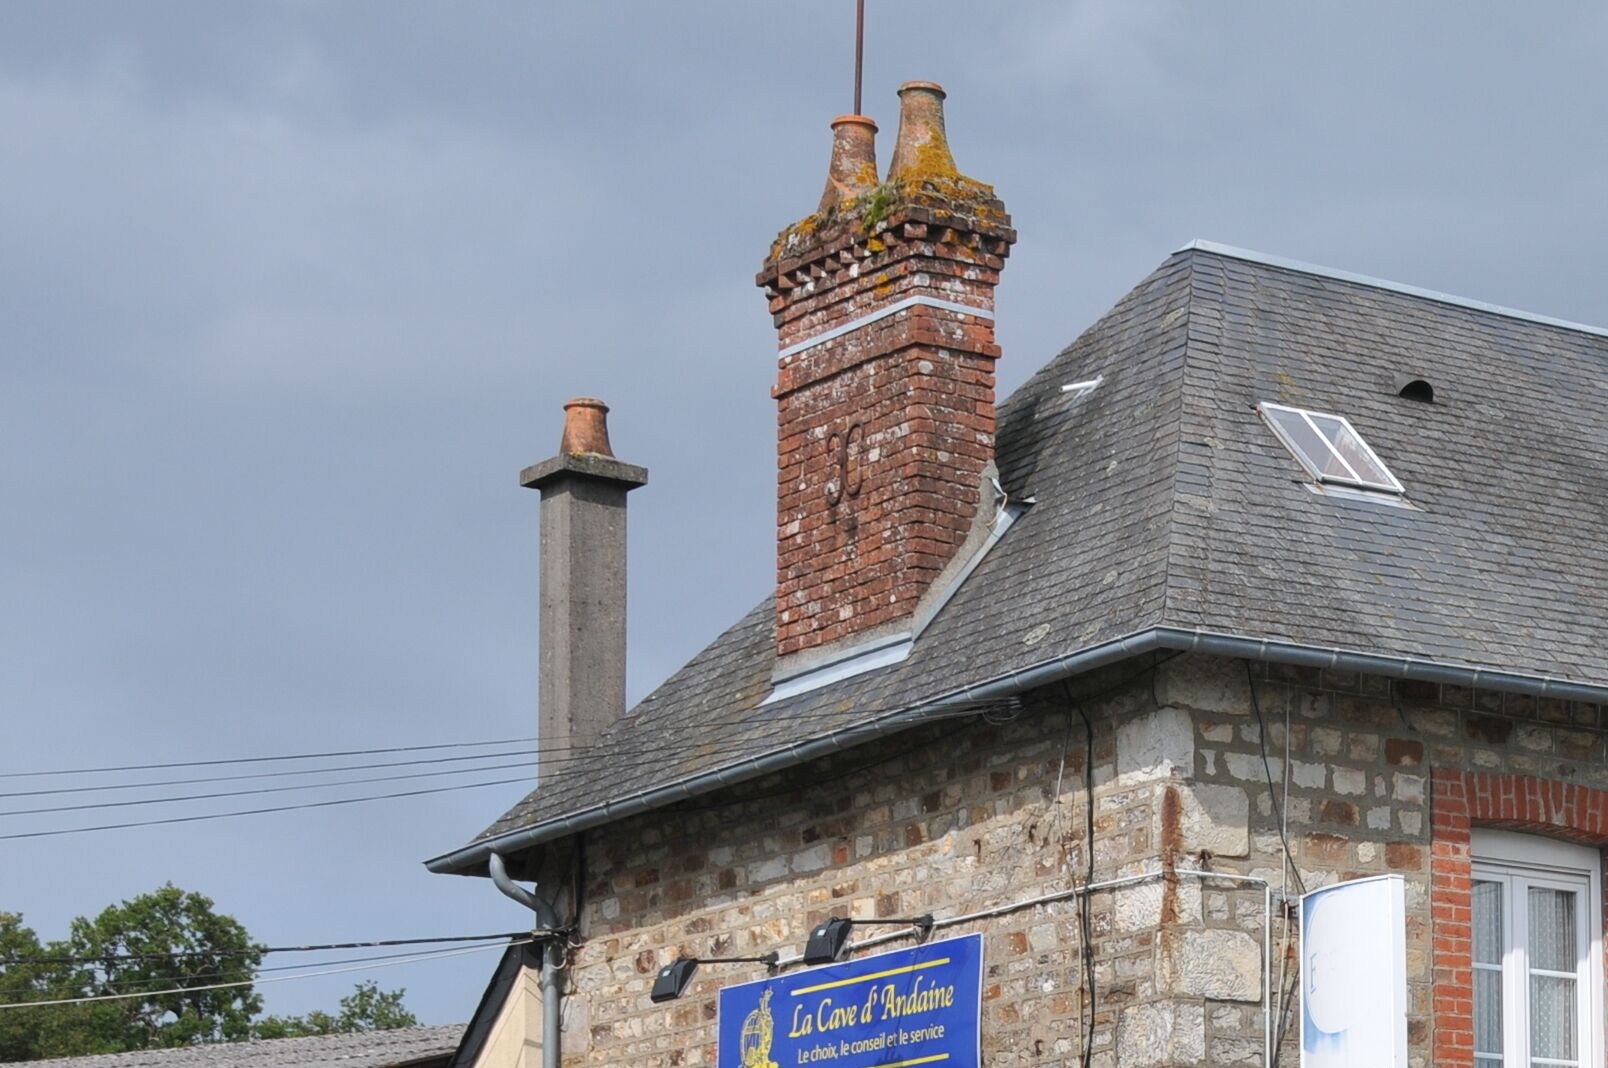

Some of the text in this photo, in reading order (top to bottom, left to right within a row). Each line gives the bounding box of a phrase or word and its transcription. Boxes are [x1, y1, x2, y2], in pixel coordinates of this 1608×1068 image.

[789, 1004, 812, 1037] La
[817, 998, 857, 1032] Cave
[798, 1024, 945, 1064] Le choix, le conseil et le service
